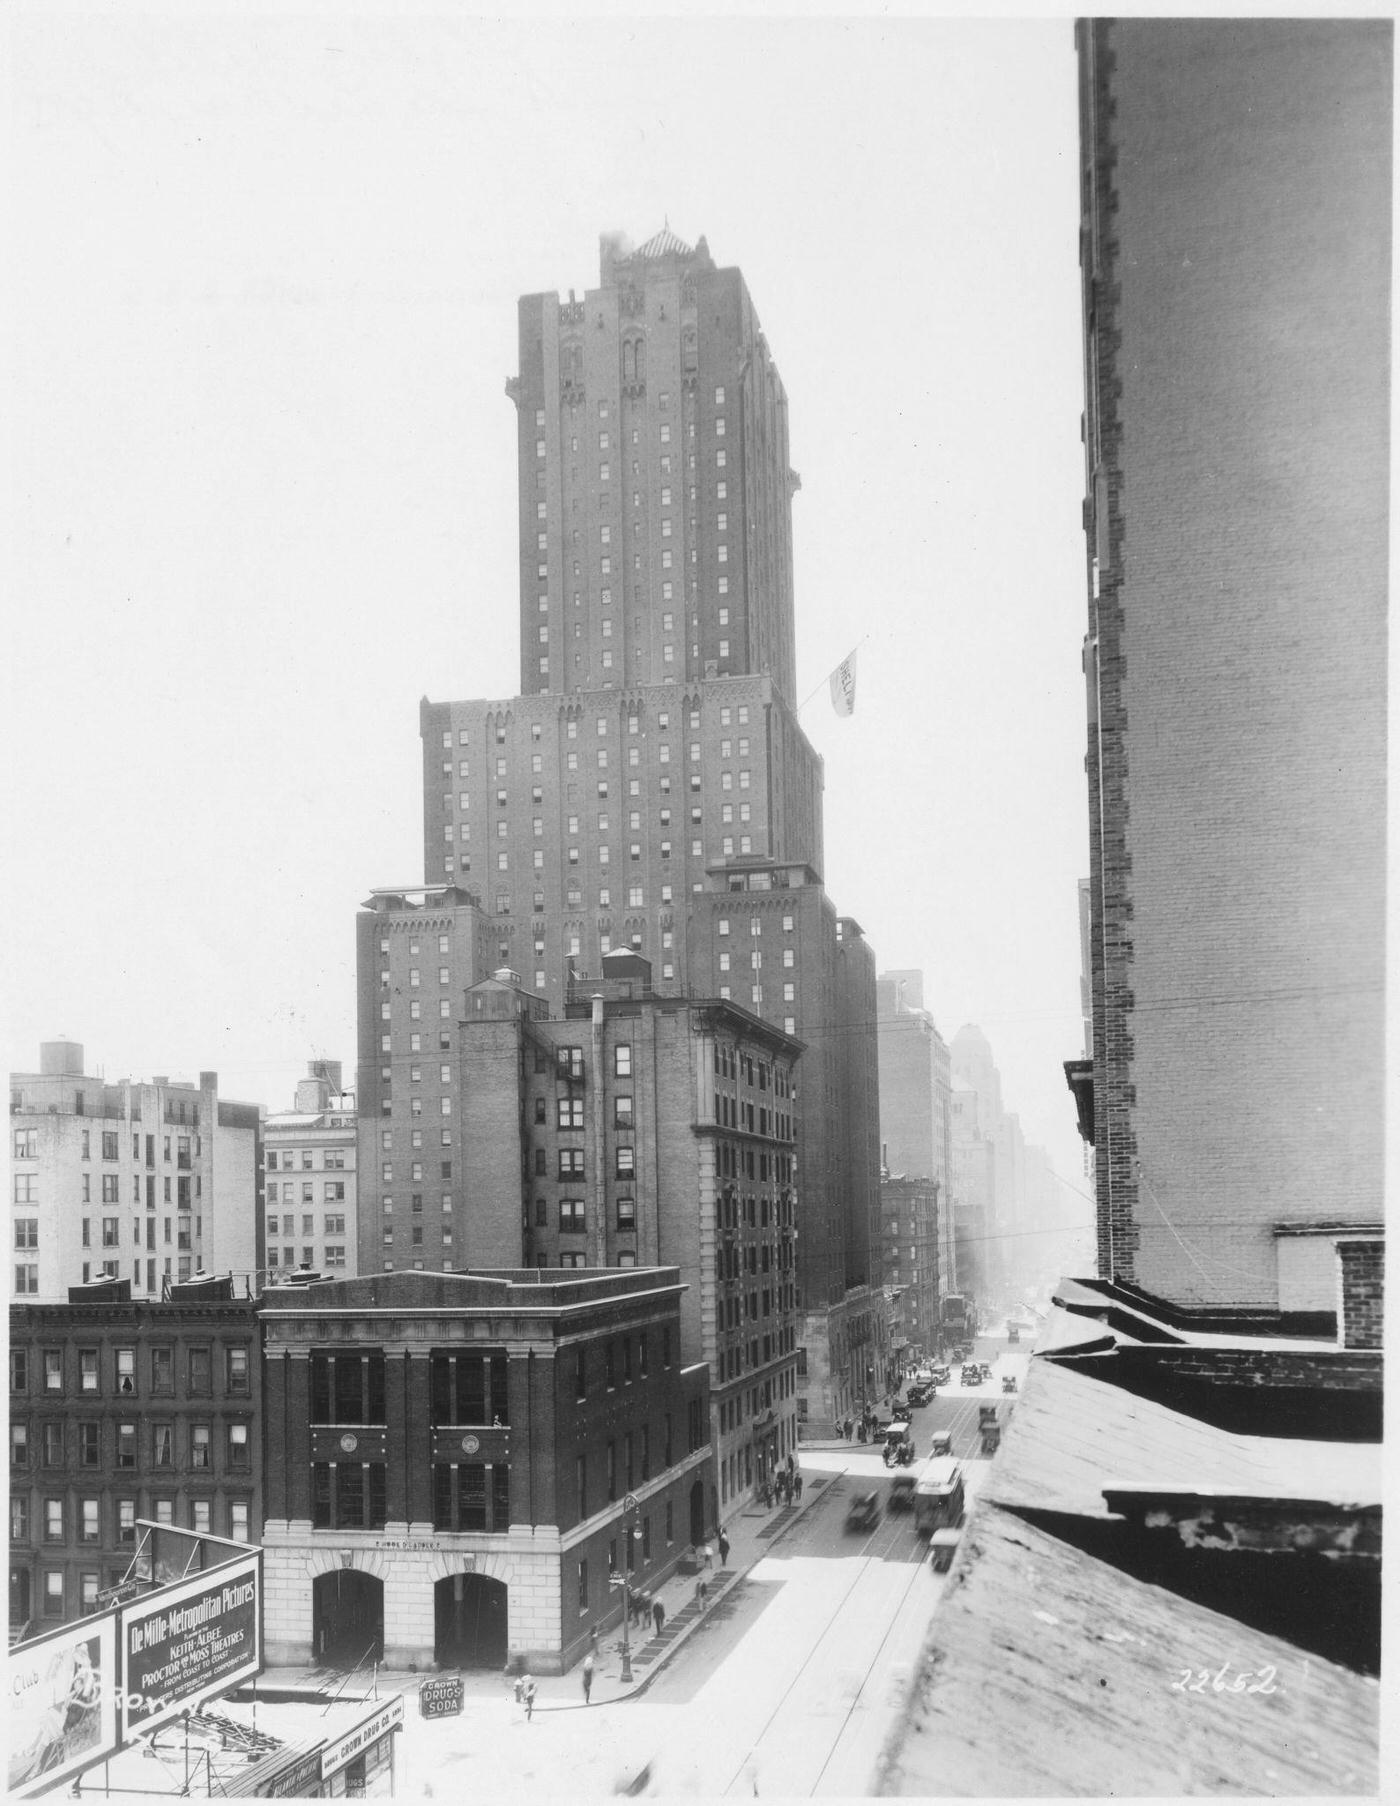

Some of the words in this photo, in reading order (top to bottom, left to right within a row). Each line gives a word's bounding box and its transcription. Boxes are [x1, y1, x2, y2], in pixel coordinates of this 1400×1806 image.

[222, 1580, 255, 1613] Pictures
[142, 1660, 180, 1689] PROCTOR
[189, 1644, 210, 1665] MOSS
[211, 1628, 244, 1655] THEATRES
[164, 1673, 182, 1688] FROM
[182, 1663, 200, 1678] COAST
[202, 1659, 210, 1669] TO
[211, 1650, 229, 1664] COAST
[174, 1670, 212, 1695] DISTRIBUTING
[213, 1651, 249, 1675] CORPORATION
[425, 1687, 461, 1700] DRUGS
[428, 1680, 458, 1689] CROWN
[429, 1700, 457, 1713] SODA
[340, 1734, 362, 1758] CROWN
[363, 1721, 380, 1742] DRUG
